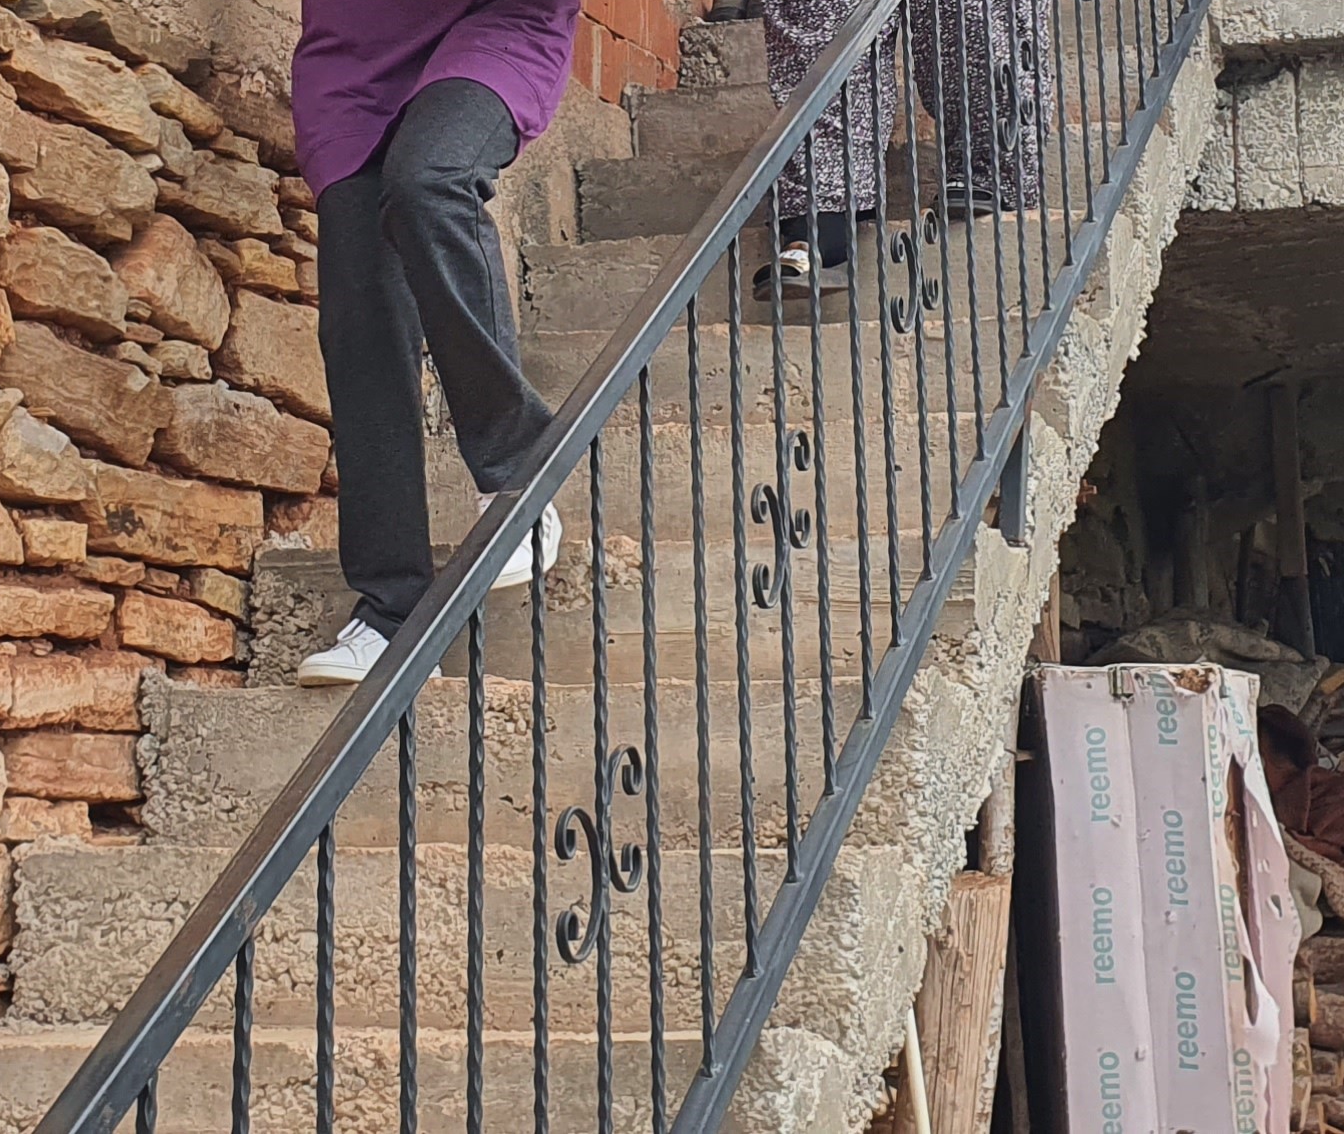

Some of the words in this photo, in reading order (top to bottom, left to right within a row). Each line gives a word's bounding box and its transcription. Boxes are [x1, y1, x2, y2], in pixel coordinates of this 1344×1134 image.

[1149, 673, 1178, 746] reem
[1086, 727, 1111, 822] reemo
[1163, 810, 1189, 906] reemo
[1092, 887, 1116, 984] reemo
[1219, 885, 1242, 981] reemo
[1175, 971, 1199, 1070] reemo
[1099, 1051, 1123, 1134] eemo
[1233, 1048, 1257, 1134] eemo
